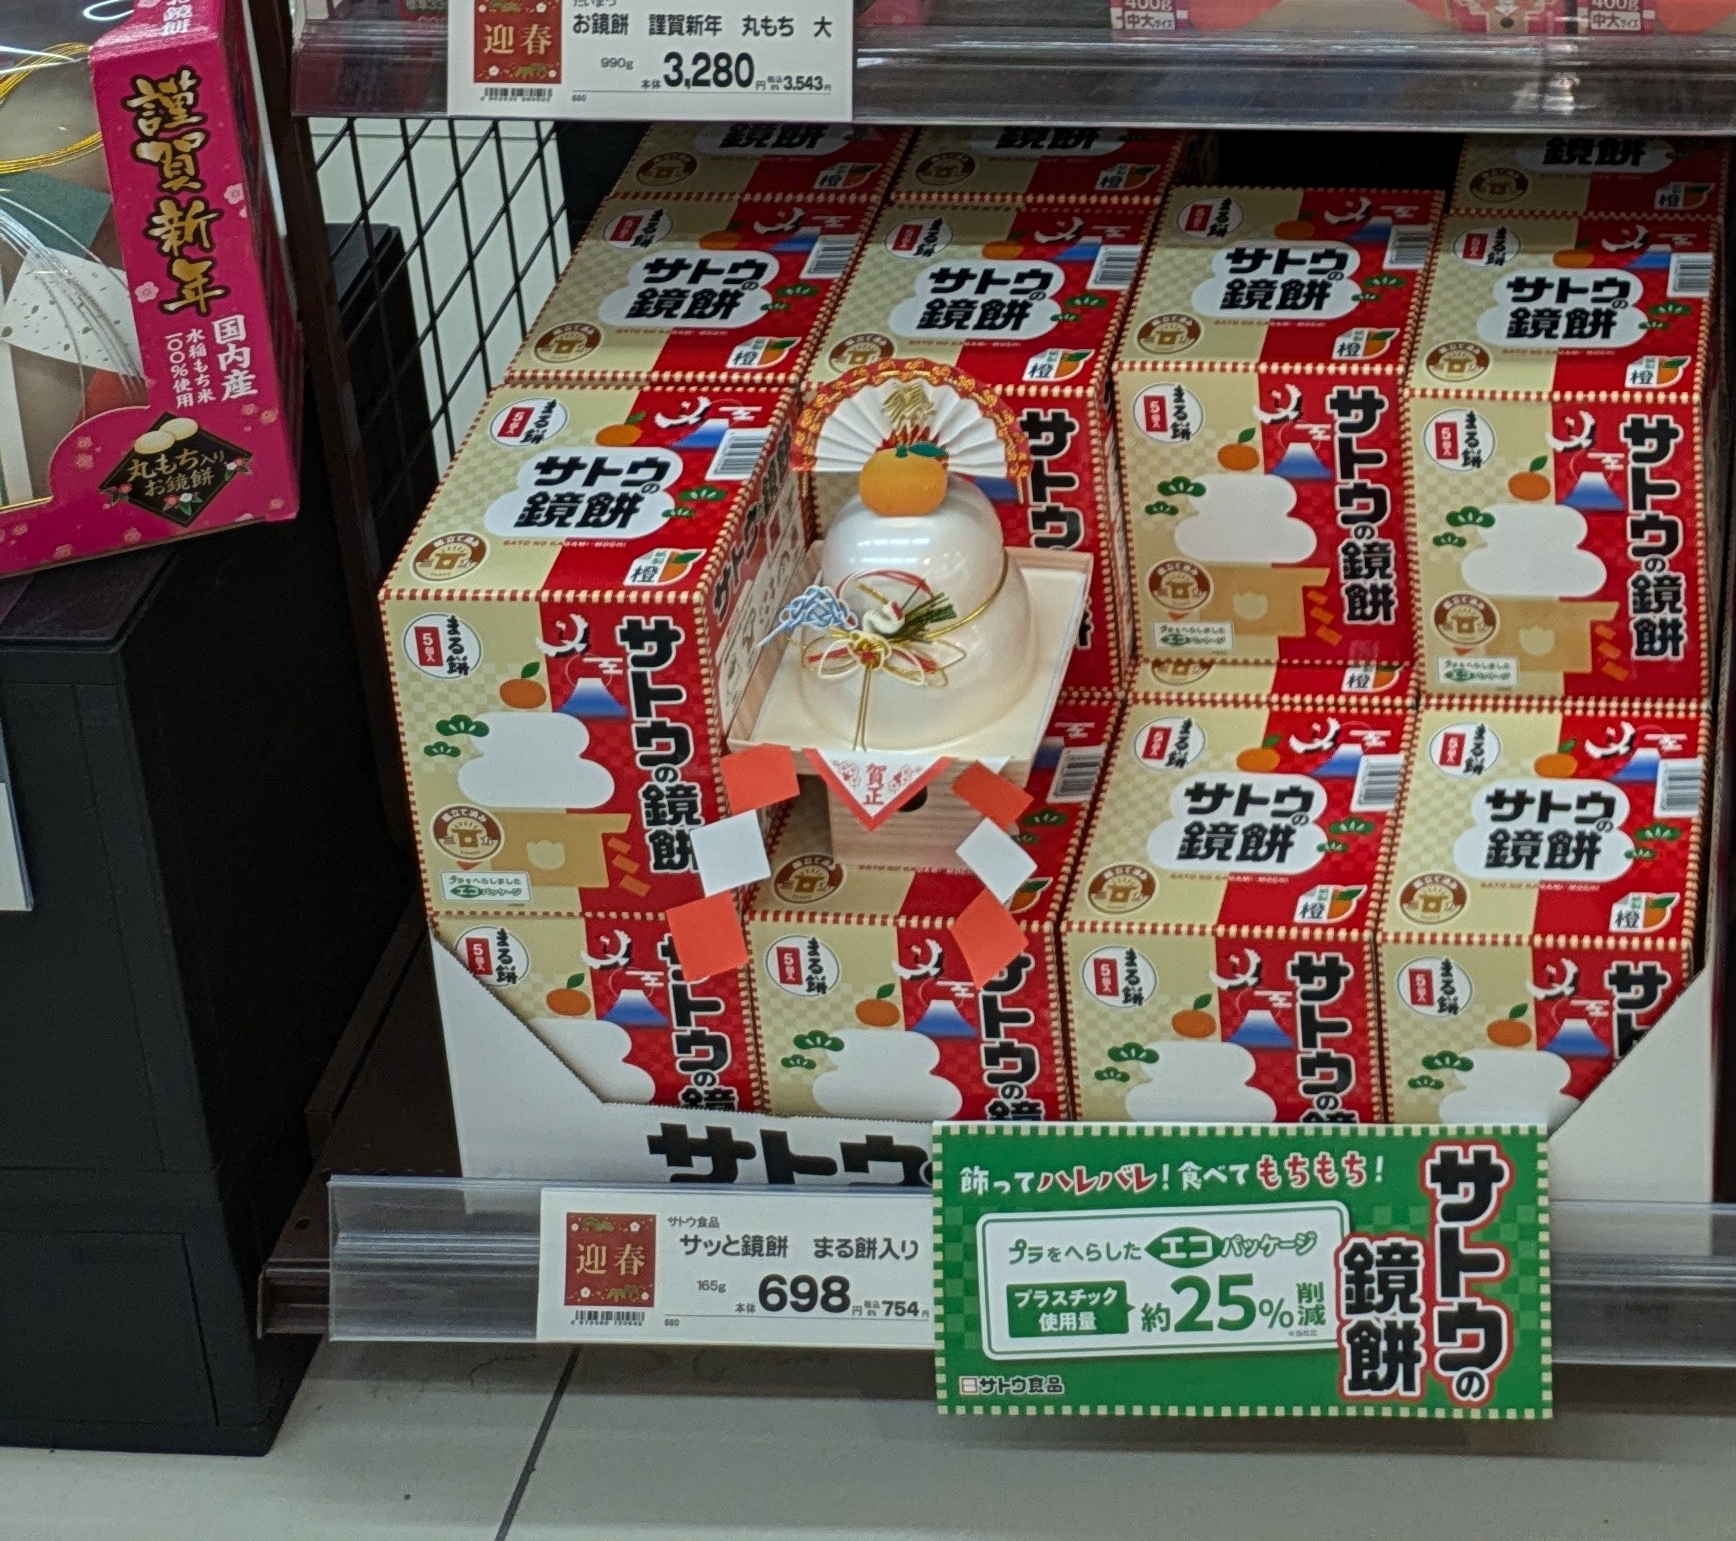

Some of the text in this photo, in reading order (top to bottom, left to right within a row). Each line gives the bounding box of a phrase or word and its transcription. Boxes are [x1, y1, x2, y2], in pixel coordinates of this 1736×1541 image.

[483, 24, 552, 55] 迎春
[572, 14, 832, 37] お鏡餅 謹賀新年 丸もち 大
[600, 58, 633, 70] 990g
[663, 51, 754, 89] 3,280
[129, 67, 228, 317] 謹賀新年
[210, 313, 259, 400] 国内産
[1620, 414, 1685, 661] サトウの鏡餅
[1177, 821, 1297, 864] 鏡餅
[667, 1216, 720, 1229] サトウ食品
[576, 1243, 645, 1276] 迎春
[680, 1234, 918, 1260] サッと鏡餅 まる餅入り
[697, 1280, 726, 1293] 165g
[1430, 1149, 1505, 1398] サトウの
[758, 1274, 851, 1313] 698
[1013, 1286, 1118, 1307] プラスチック
[1039, 1312, 1098, 1332] 使用量
[1343, 1240, 1423, 1395] 鏡餅
[979, 1376, 1064, 1395] サトウ食品
